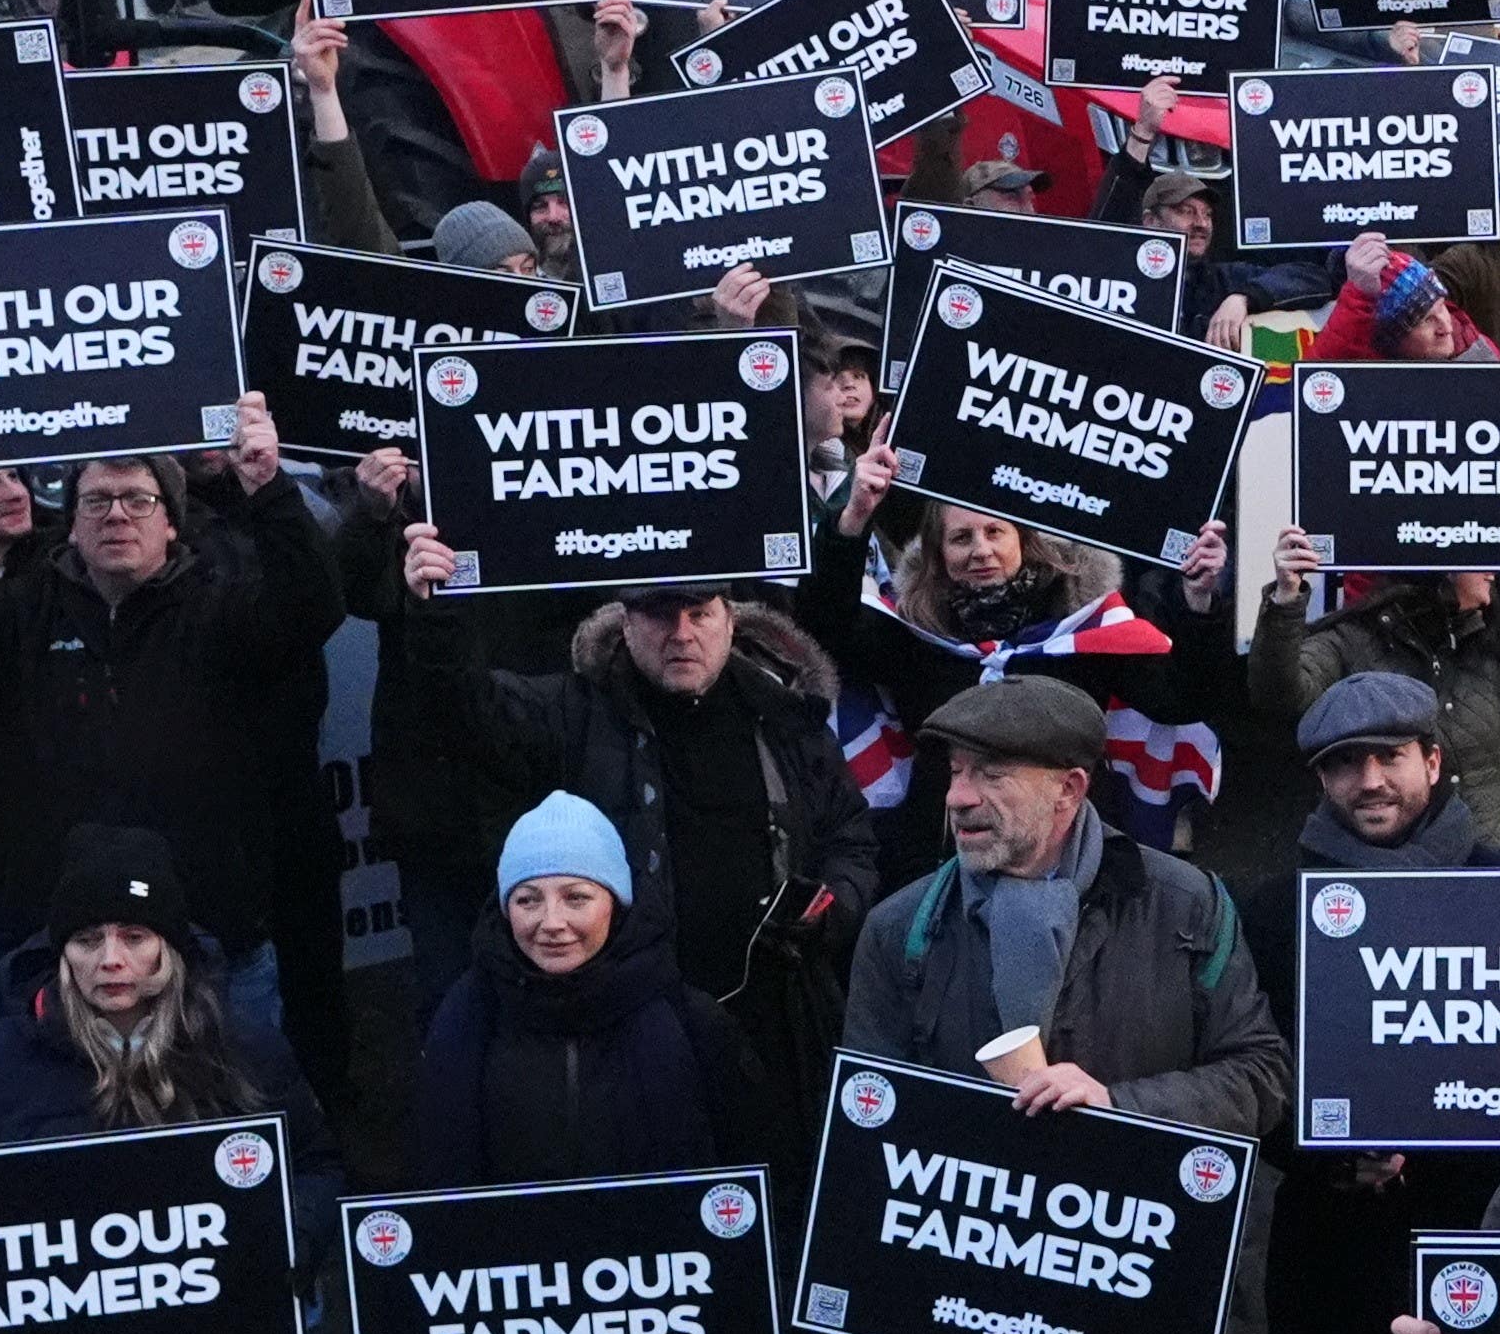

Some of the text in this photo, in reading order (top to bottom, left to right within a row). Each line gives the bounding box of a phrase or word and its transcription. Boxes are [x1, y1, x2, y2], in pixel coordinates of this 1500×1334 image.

[1088, 6, 1239, 40] FARMERS
[1122, 54, 1206, 75] #together
[1004, 75, 1045, 108] 7726
[1270, 114, 1458, 148] WITH OUR
[608, 129, 829, 190] WITH OUR
[1280, 148, 1452, 182] FARMERS
[625, 168, 826, 229] FARMERS
[1323, 202, 1418, 225] #together
[684, 236, 793, 269] #together
[65, 280, 181, 324] OUR
[967, 341, 1193, 443] WITH OUR
[475, 402, 748, 452] WITH OUR
[957, 378, 1172, 478] FARMERS
[1339, 421, 1456, 454] WITH
[492, 449, 740, 500] FARMERS
[992, 465, 1110, 515] #together
[555, 525, 692, 558] #together
[883, 1143, 1175, 1249] WITH OUR
[91, 1203, 228, 1259] OUR
[881, 1191, 1154, 1298] FARMERS
[410, 1252, 713, 1316] WITH OUR
